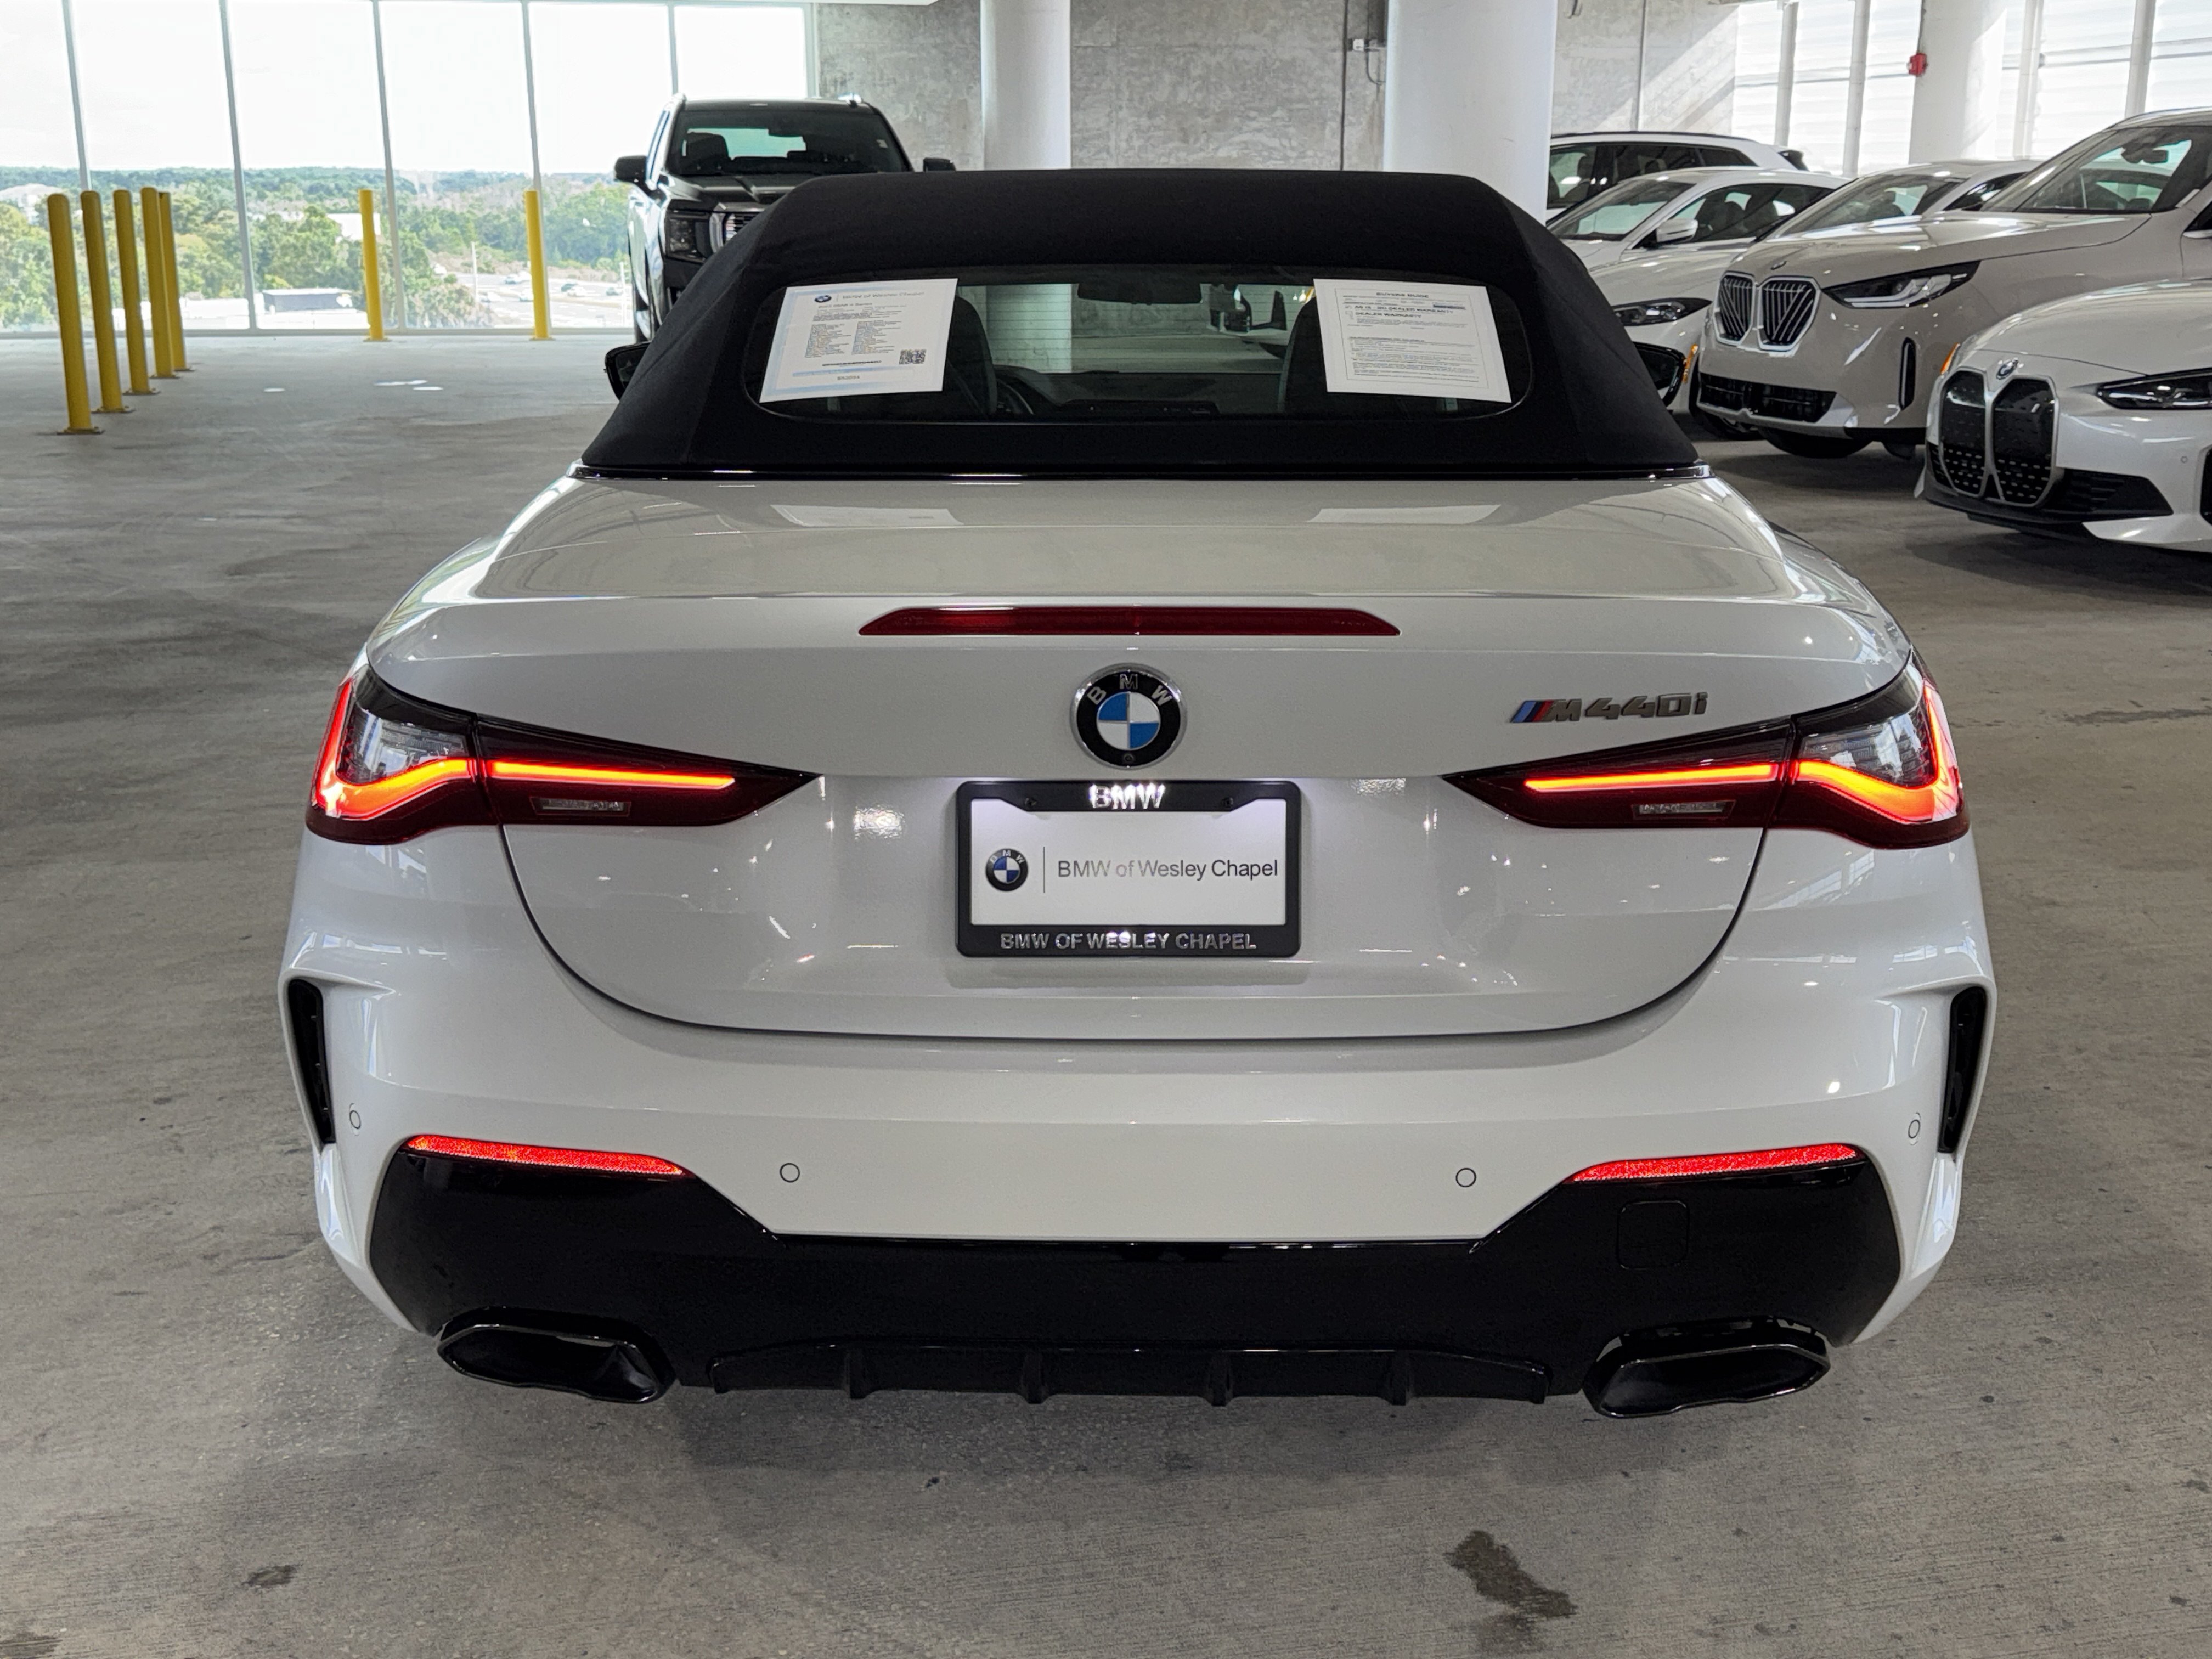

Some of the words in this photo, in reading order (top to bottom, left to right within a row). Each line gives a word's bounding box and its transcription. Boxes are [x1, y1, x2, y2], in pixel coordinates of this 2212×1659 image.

[1087, 674, 1172, 706] BMW
[1088, 783, 1166, 809] BMW
[990, 850, 1025, 864] BMW
[1058, 861, 1111, 878] BMW
[1115, 860, 1135, 878] of
[1138, 860, 1207, 881] Wesley
[1212, 860, 1278, 881] Chapel
[1001, 934, 1049, 950] BMW
[1056, 934, 1082, 950] OF
[1087, 932, 1170, 950] WESLEY
[1176, 933, 1257, 950] CHAPEL
